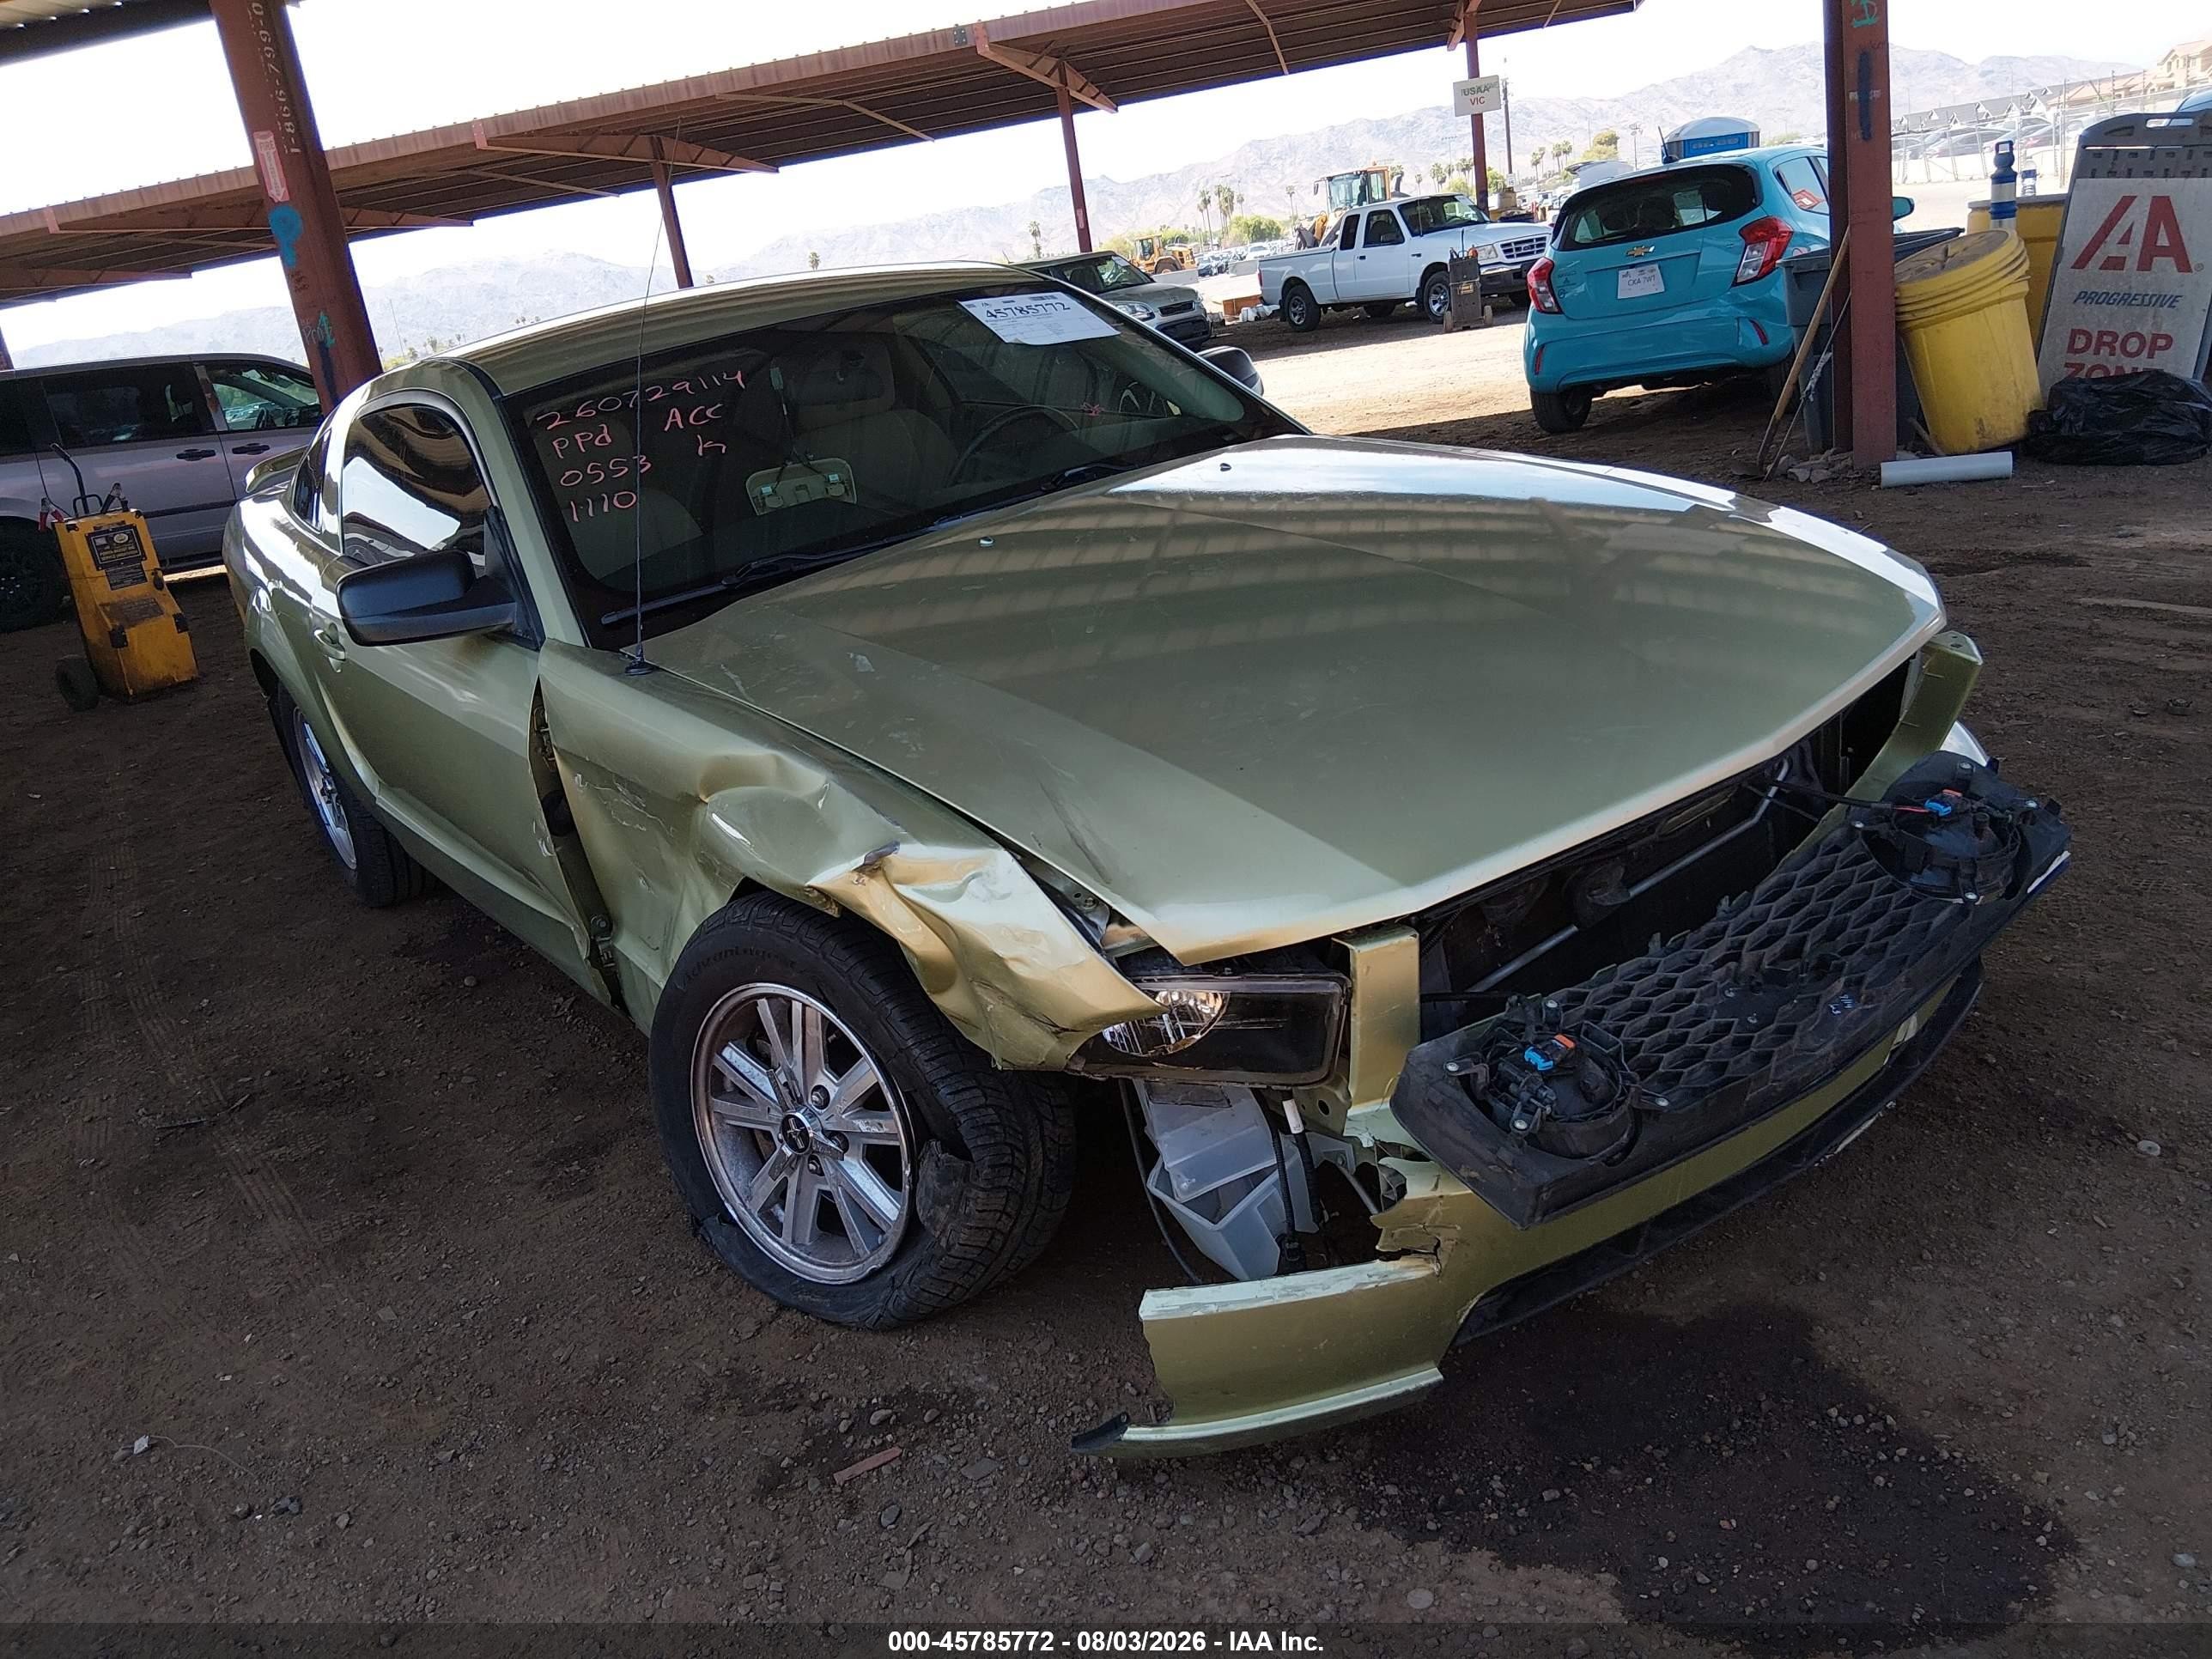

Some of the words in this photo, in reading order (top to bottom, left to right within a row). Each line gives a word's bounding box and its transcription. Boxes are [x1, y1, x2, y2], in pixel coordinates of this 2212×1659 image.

[1470, 96, 1486, 106] VIC
[2073, 291, 2184, 309] PROGRESSIVE
[987, 302, 1071, 319] 45785772
[2066, 328, 2173, 359] DROP
[537, 370, 745, 429] 260729114
